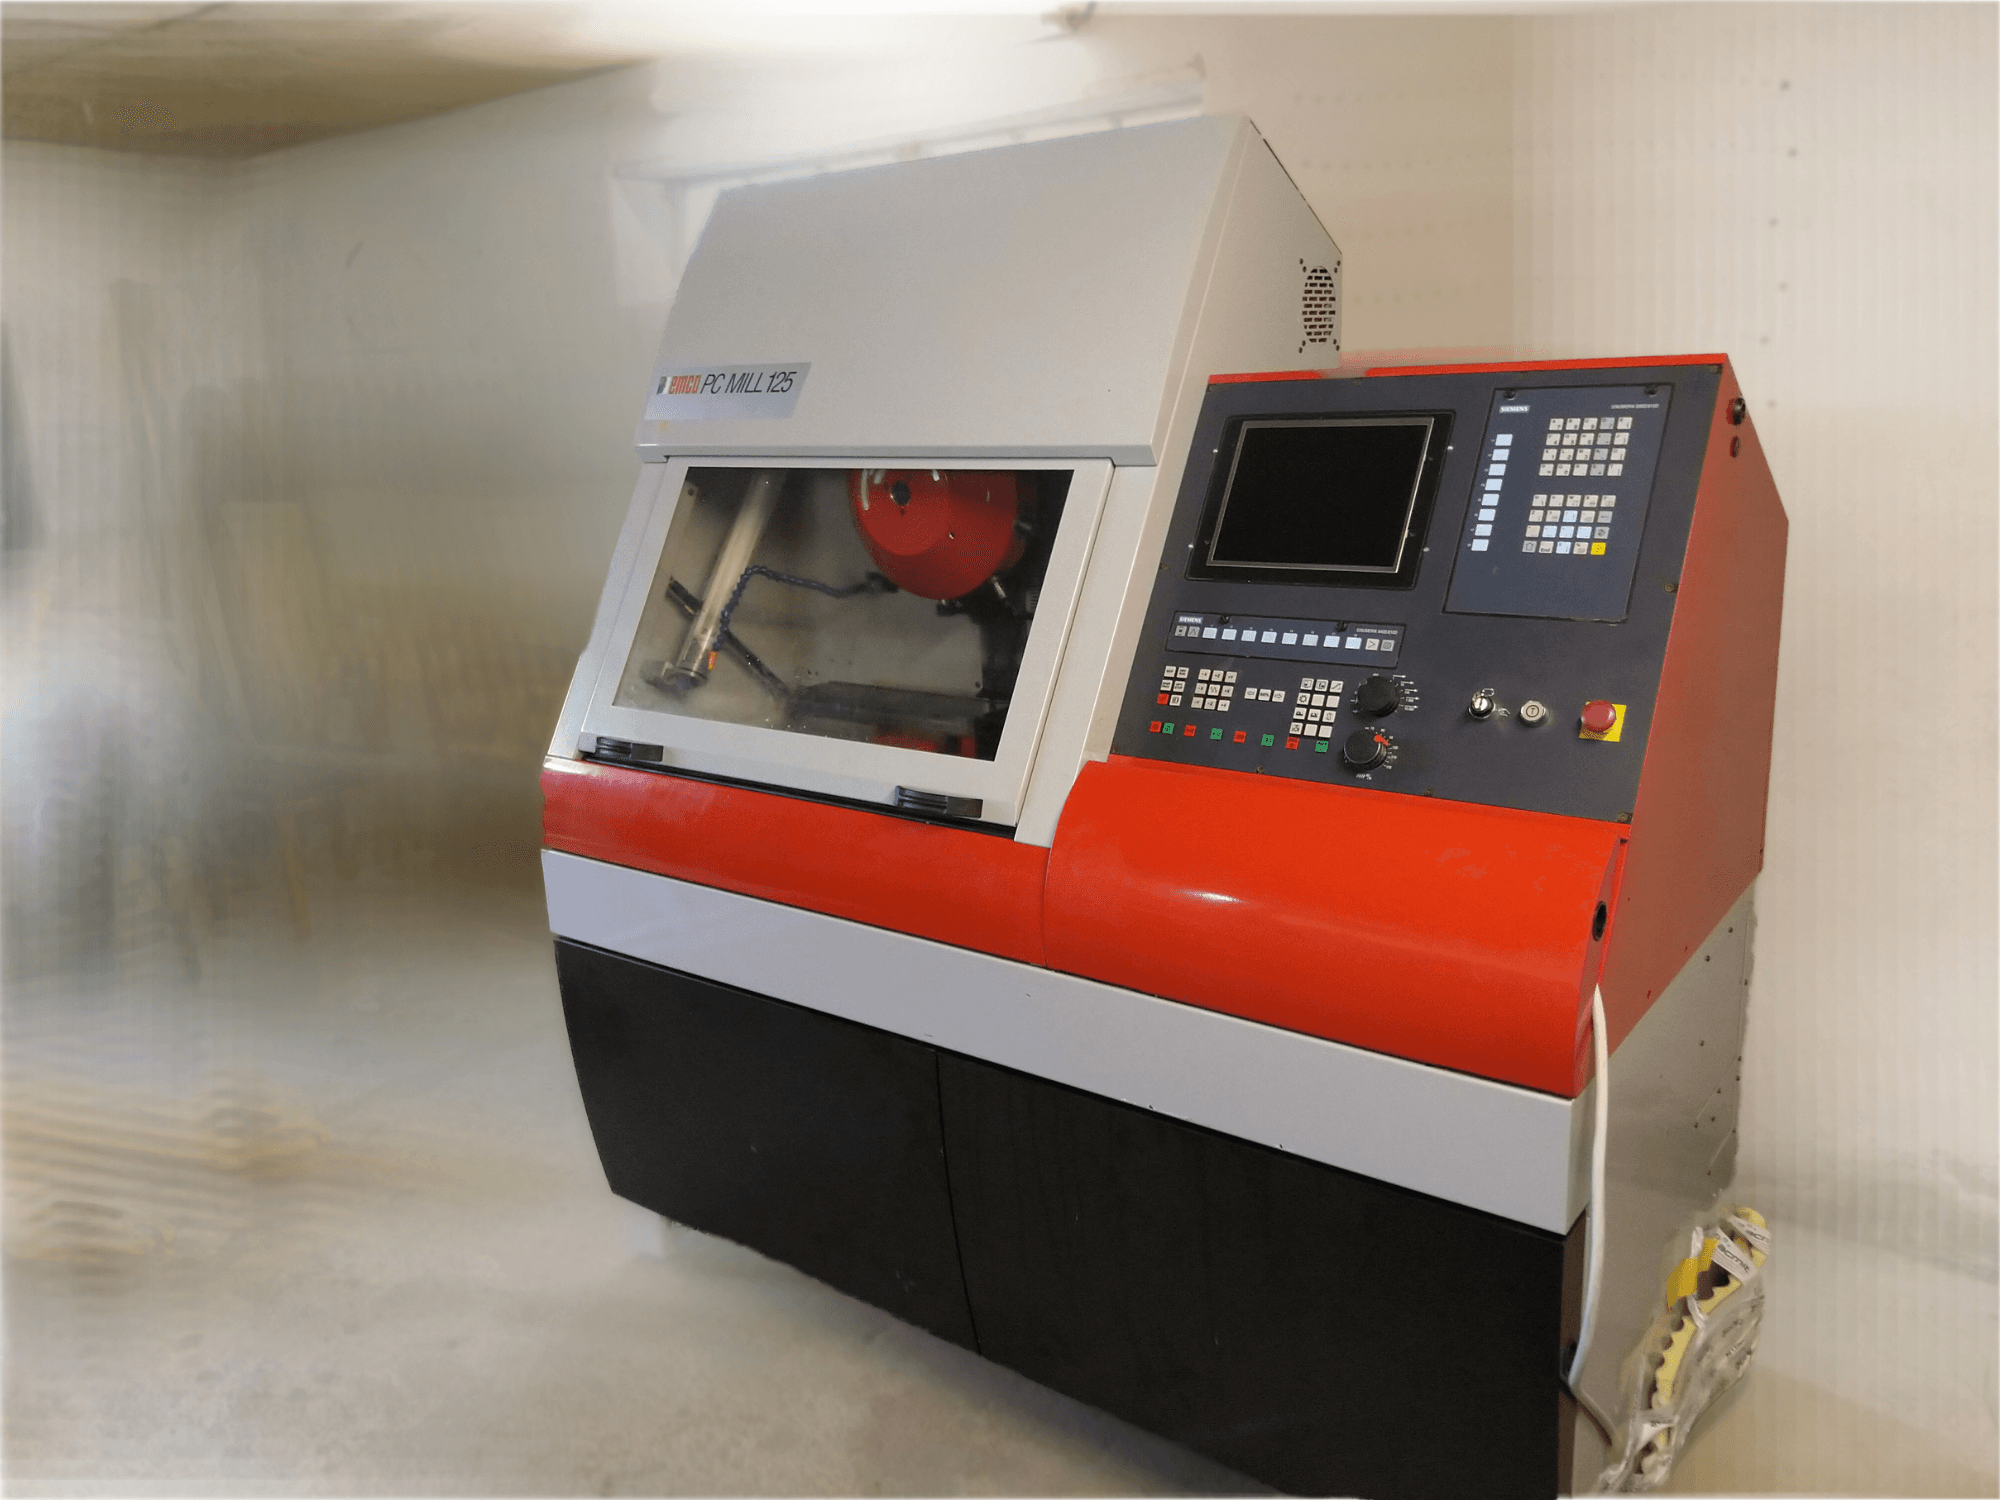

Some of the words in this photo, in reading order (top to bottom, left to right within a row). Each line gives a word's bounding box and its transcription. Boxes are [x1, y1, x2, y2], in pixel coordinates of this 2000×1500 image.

[669, 375, 701, 395] emco
[700, 373, 726, 394] PC
[724, 372, 763, 394] MILL
[766, 371, 798, 393] 125
[1500, 404, 1530, 413] SIEMENS
[1178, 615, 1203, 624] SIEMENS
